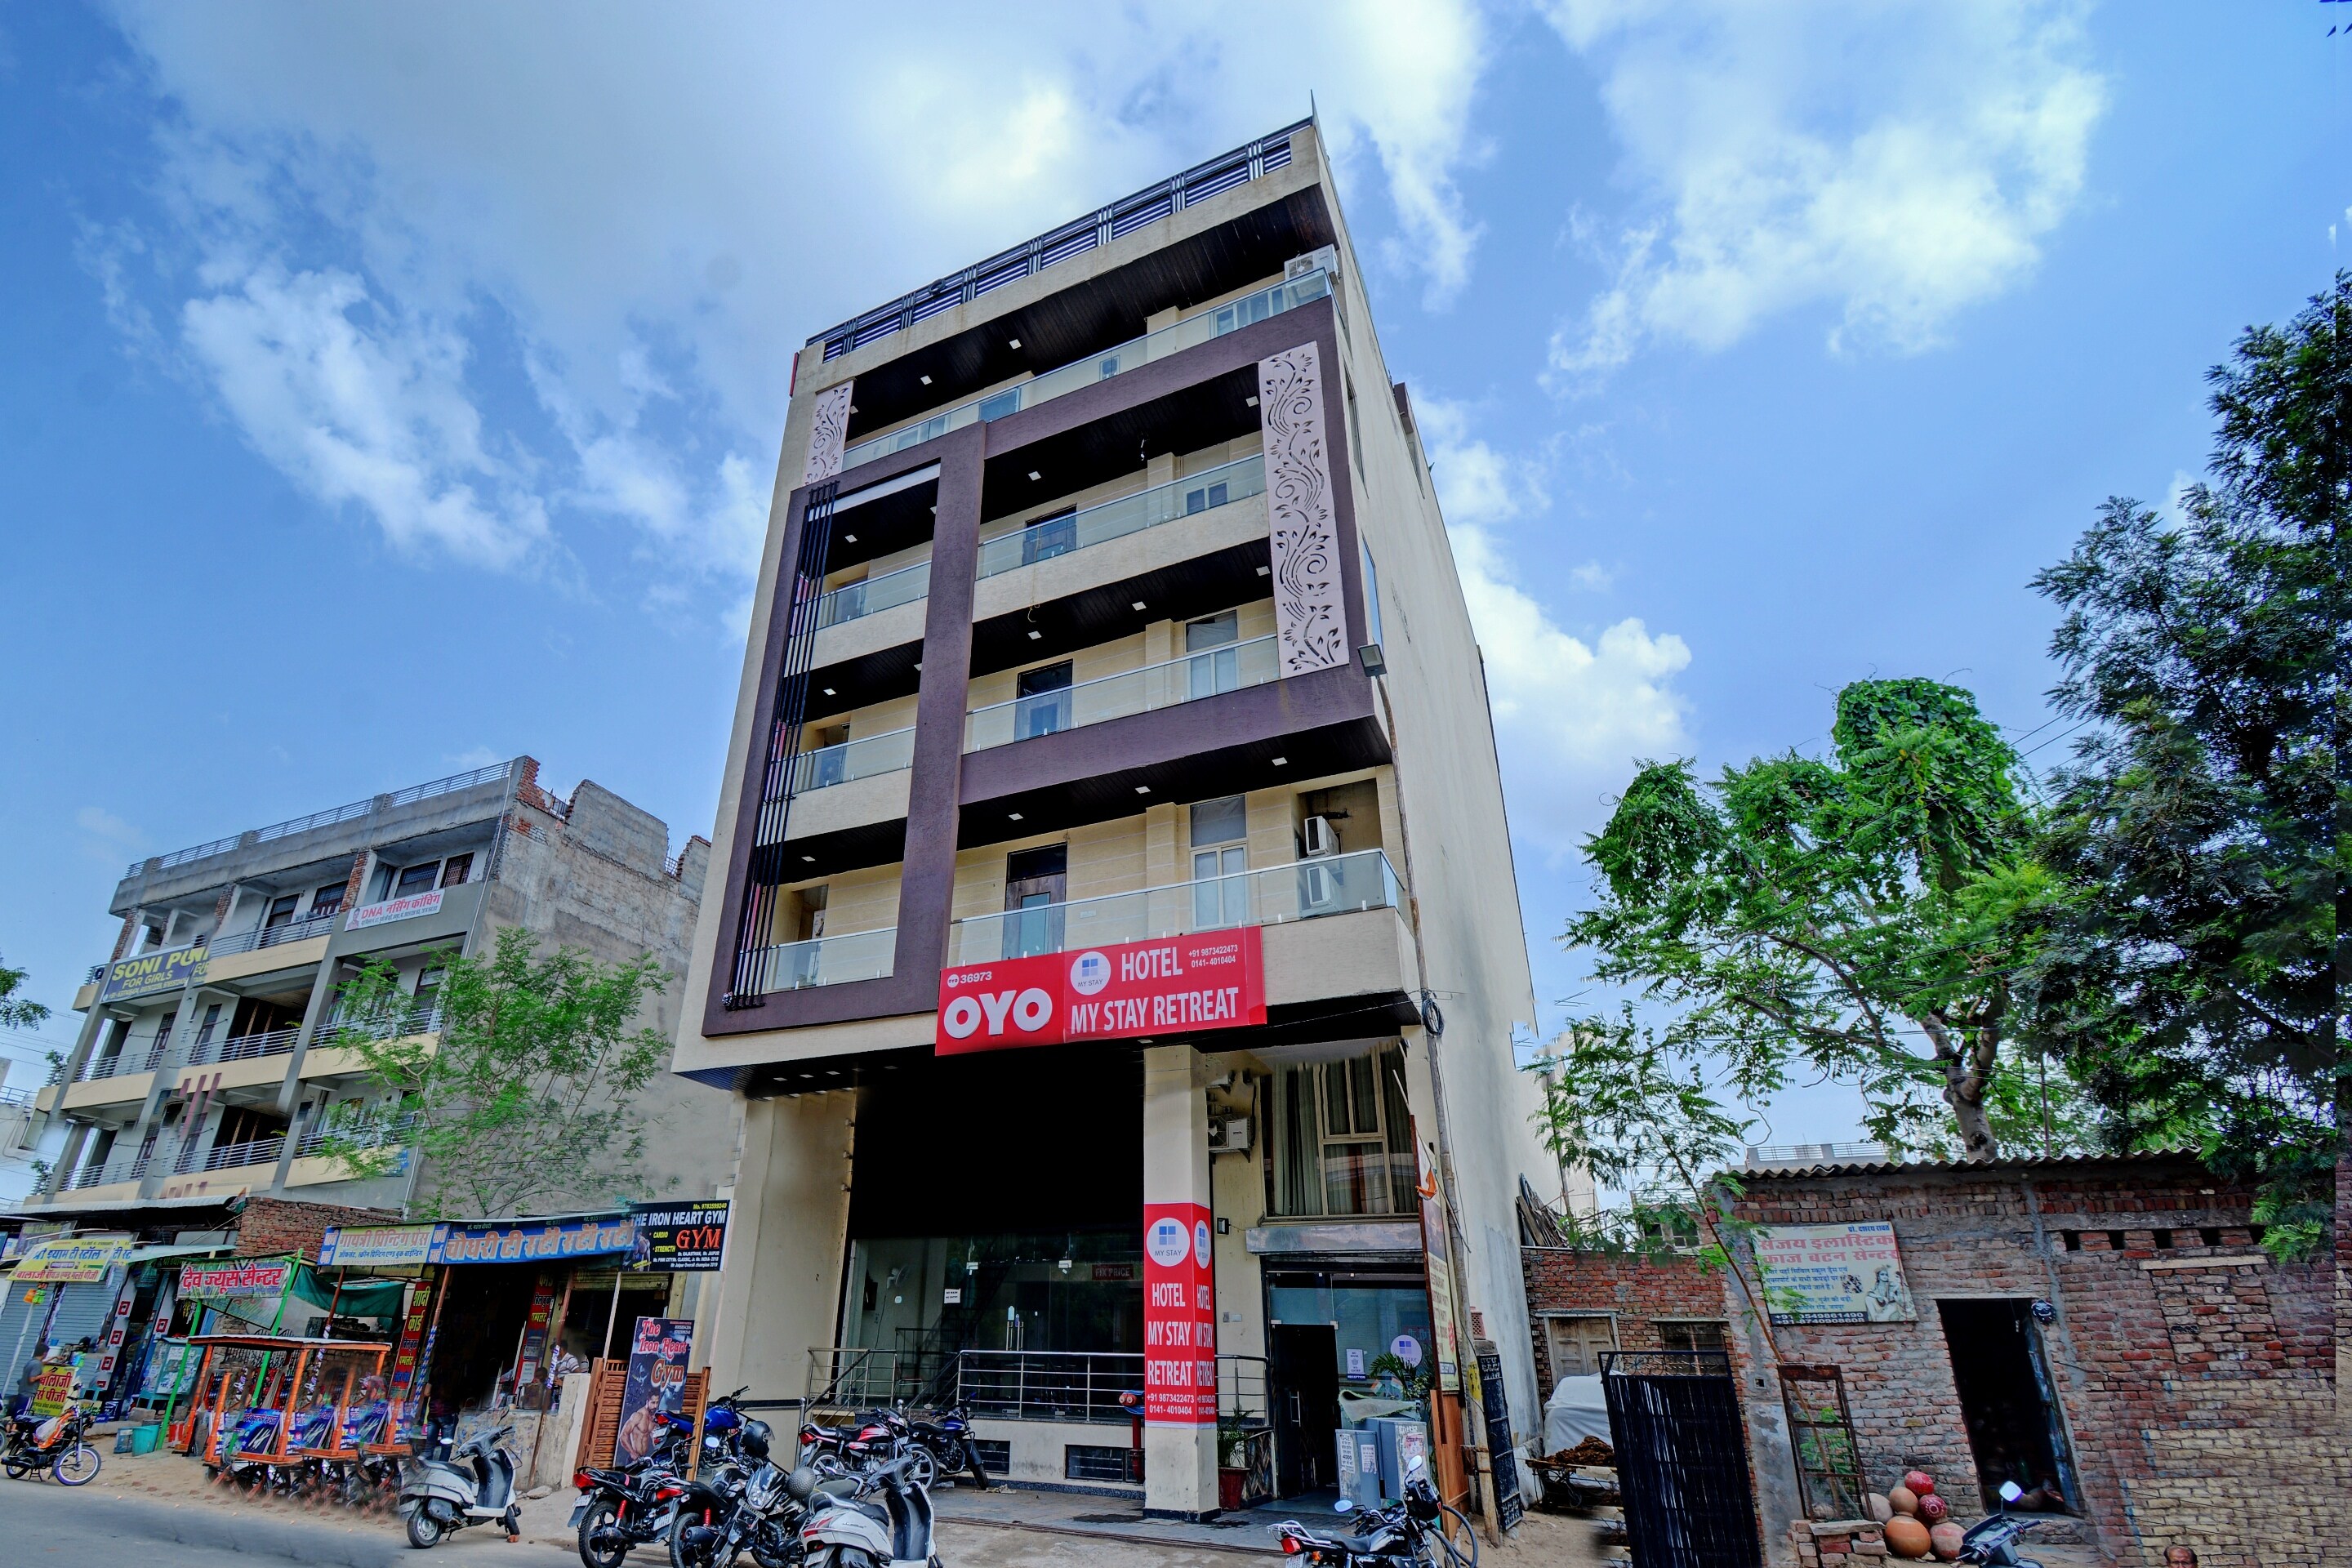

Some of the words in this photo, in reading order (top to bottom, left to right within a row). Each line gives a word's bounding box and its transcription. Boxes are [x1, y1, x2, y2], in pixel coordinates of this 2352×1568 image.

[361, 906, 382, 919] DNA
[1201, 945, 1238, 957] 9873422473
[112, 956, 163, 981] SONI
[1121, 947, 1183, 982] HOTEL
[122, 976, 141, 990] FOR
[145, 970, 173, 984] GIRLS
[960, 971, 992, 984] 36973
[1089, 978, 1103, 987] STAY
[943, 987, 1053, 1039] OYO
[1071, 1003, 1100, 1035] MY
[1104, 997, 1149, 1031] STAY
[1153, 987, 1239, 1027] RETREAT
[648, 1213, 671, 1227] IRON
[672, 1211, 704, 1226] HEART
[705, 1210, 727, 1224] GYM
[339, 1228, 372, 1248] गायत्री
[446, 1232, 501, 1261] चौधरी
[501, 1230, 523, 1259] टी
[676, 1225, 721, 1250] GYM
[1807, 1251, 1846, 1263] बटन
[16, 1270, 45, 1279] बालाजी
[182, 1266, 203, 1290] देव
[204, 1269, 240, 1294] ज्यूस
[242, 1263, 283, 1288] सेन्टर
[1095, 1267, 1107, 1277] FIX
[1108, 1267, 1130, 1277] PRICE
[1152, 1283, 1186, 1307] HOTEL
[1197, 1284, 1211, 1310] HOTEL
[642, 1321, 661, 1335] The
[1147, 1321, 1164, 1345] MY
[1166, 1321, 1192, 1346] STAY
[1203, 1322, 1214, 1348] STAY
[639, 1338, 659, 1352] Iron
[662, 1338, 687, 1360] Heart
[651, 1359, 684, 1390] Gym
[1147, 1360, 1192, 1387] RETREAT
[1196, 1360, 1214, 1387] RETREAT
[1159, 1394, 1195, 1403] 9873422473
[1167, 1405, 1192, 1415] 4010404
